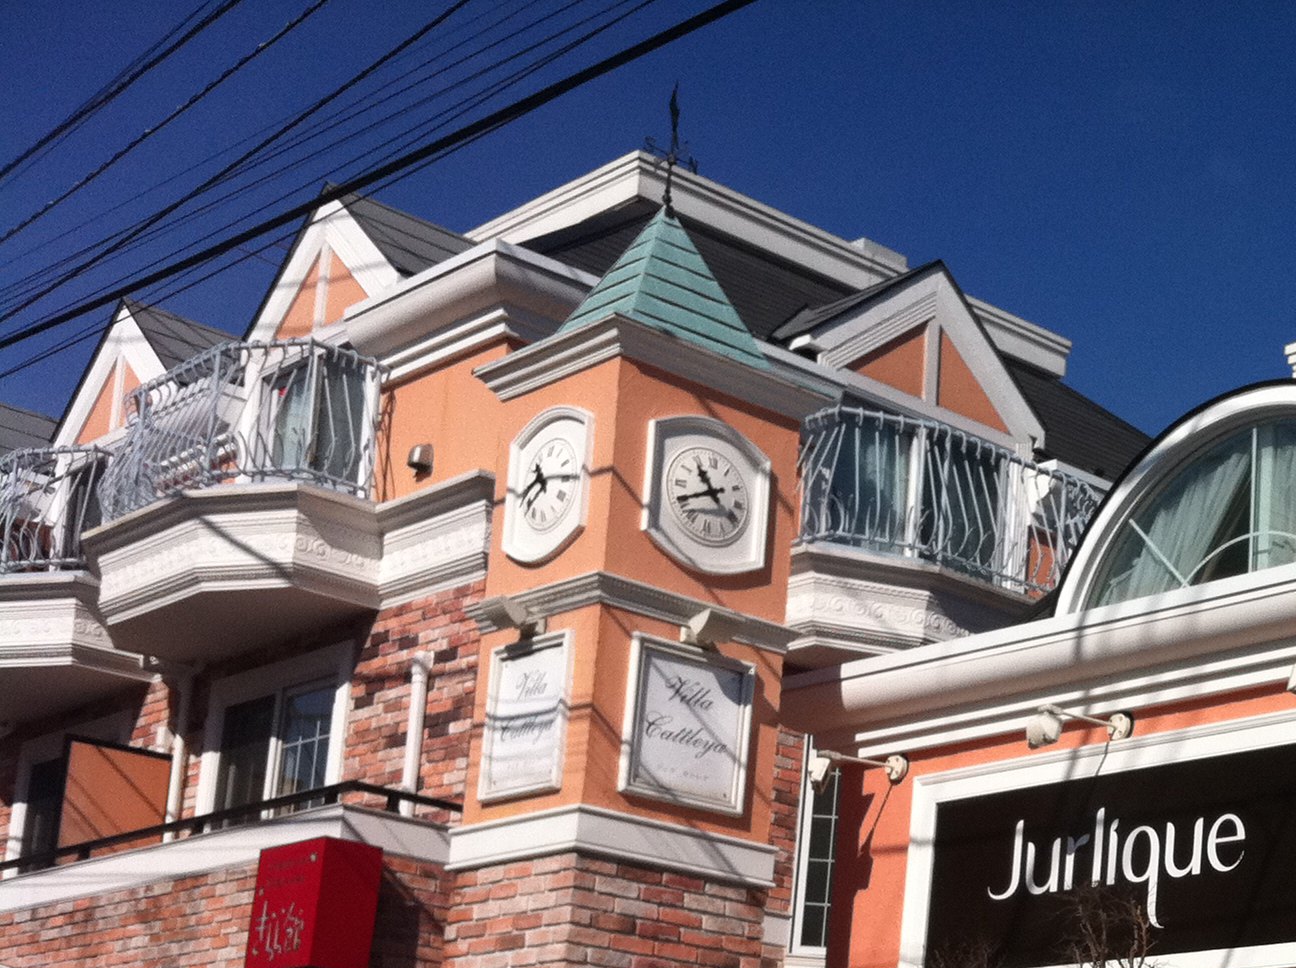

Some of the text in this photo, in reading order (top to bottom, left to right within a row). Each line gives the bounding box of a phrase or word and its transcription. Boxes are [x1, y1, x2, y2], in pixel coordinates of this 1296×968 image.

[666, 674, 715, 711] Villa
[645, 711, 727, 760] Cattleya
[987, 807, 1246, 929] Jurlique
